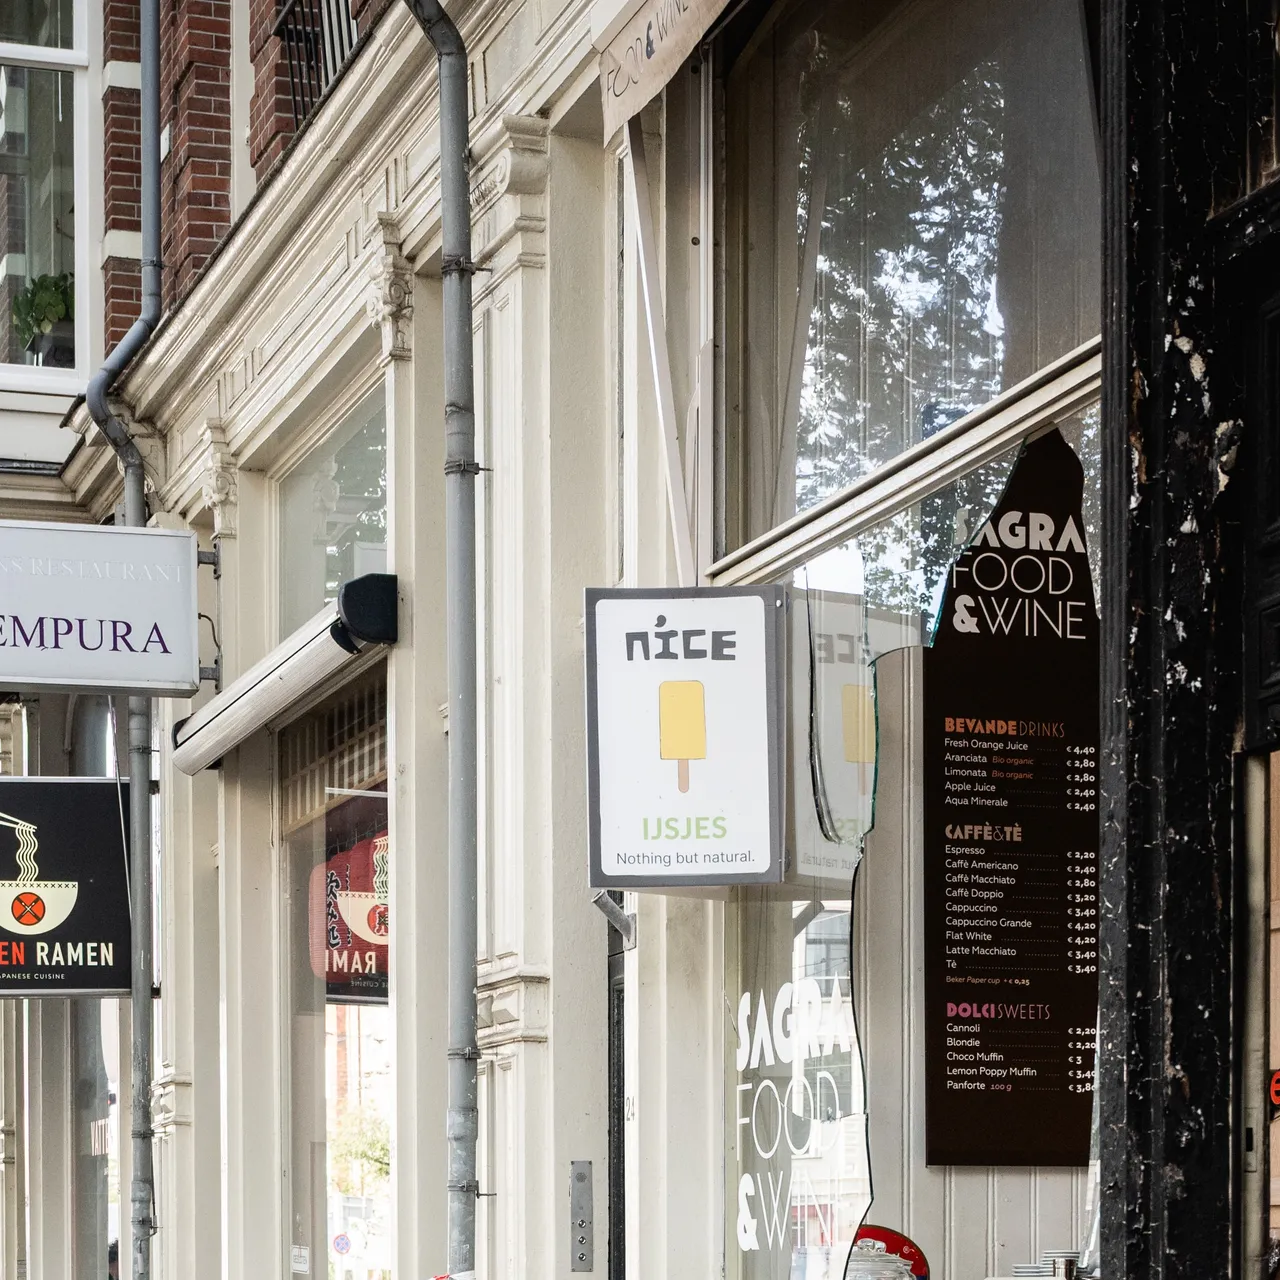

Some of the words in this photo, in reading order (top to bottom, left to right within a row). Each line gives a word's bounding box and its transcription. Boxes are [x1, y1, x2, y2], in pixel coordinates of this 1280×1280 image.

[656, 0, 688, 42] WIN
[953, 508, 1086, 553] SAGRA
[28, 556, 186, 584] RESTAURANT
[952, 551, 1074, 595] FOOD
[945, 738, 969, 747] Fresh
[970, 739, 1004, 751] Orange
[1006, 741, 1028, 751] Juice
[1073, 746, 1095, 755] 4,40
[944, 752, 988, 763] Aranciata
[992, 755, 1005, 764] Bio
[1006, 758, 1034, 766] organic
[1074, 759, 1095, 768] 2,80
[945, 767, 987, 777] Limonata
[991, 770, 1005, 778] Bio
[1005, 772, 1033, 780] organic
[1074, 773, 1095, 783] 2,80
[945, 781, 972, 792] Apple
[973, 783, 996, 792] Juice
[1074, 789, 1095, 798] 2,40
[945, 796, 969, 806] Aqua
[971, 797, 1008, 807] Minerale
[1074, 803, 1095, 812] 2,40
[642, 816, 728, 841] IJSJES
[616, 852, 672, 867] Nothing
[676, 851, 699, 865] but
[703, 850, 755, 865] natural.
[945, 844, 985, 855] Espresso
[1075, 852, 1095, 860] 2,20
[945, 859, 969, 869] Caffè
[971, 860, 1019, 870] Americano
[1075, 866, 1096, 875] 2,40
[945, 873, 969, 883] Caffè
[971, 874, 1016, 885] Macchiato
[1075, 878, 1096, 888] 2,80
[945, 887, 969, 897] Caffè
[971, 888, 1004, 900] Doppio
[1075, 894, 1096, 903] 3,20
[945, 902, 998, 913] Cappuccino
[1075, 908, 1096, 917] 3,40
[946, 916, 998, 927] Cappuccino
[999, 918, 1032, 928] Grande
[1075, 923, 1096, 931] 4,20
[946, 931, 964, 940] Flat
[965, 932, 992, 941] White
[1075, 937, 1096, 945] 4,20
[35, 942, 114, 967] RAMEN
[946, 945, 970, 954] Latte
[972, 946, 1017, 956] Macchiato
[1075, 951, 1096, 960] 3,40
[946, 959, 957, 969] Tè
[1075, 965, 1096, 974] 3,40
[946, 975, 966, 983] Beker
[966, 976, 987, 984] Paper
[736, 970, 851, 1072] SAGRA
[946, 1023, 980, 1032] Cannoli
[1075, 1027, 1096, 1036] 2,20
[947, 1037, 980, 1047] Blondie
[1075, 1041, 1096, 1050] 2,20
[946, 1051, 975, 1061] Choco
[976, 1052, 1004, 1061] Muffin
[1076, 1056, 1082, 1065] 3
[947, 1066, 978, 1075] Lemon
[979, 1066, 1008, 1078] Poppy
[1009, 1067, 1037, 1076] Muffin
[947, 1080, 986, 1090] Panforte
[1006, 1084, 1012, 1092] g
[626, 1096, 636, 1122] 24
[736, 1070, 840, 1161] FOOD
